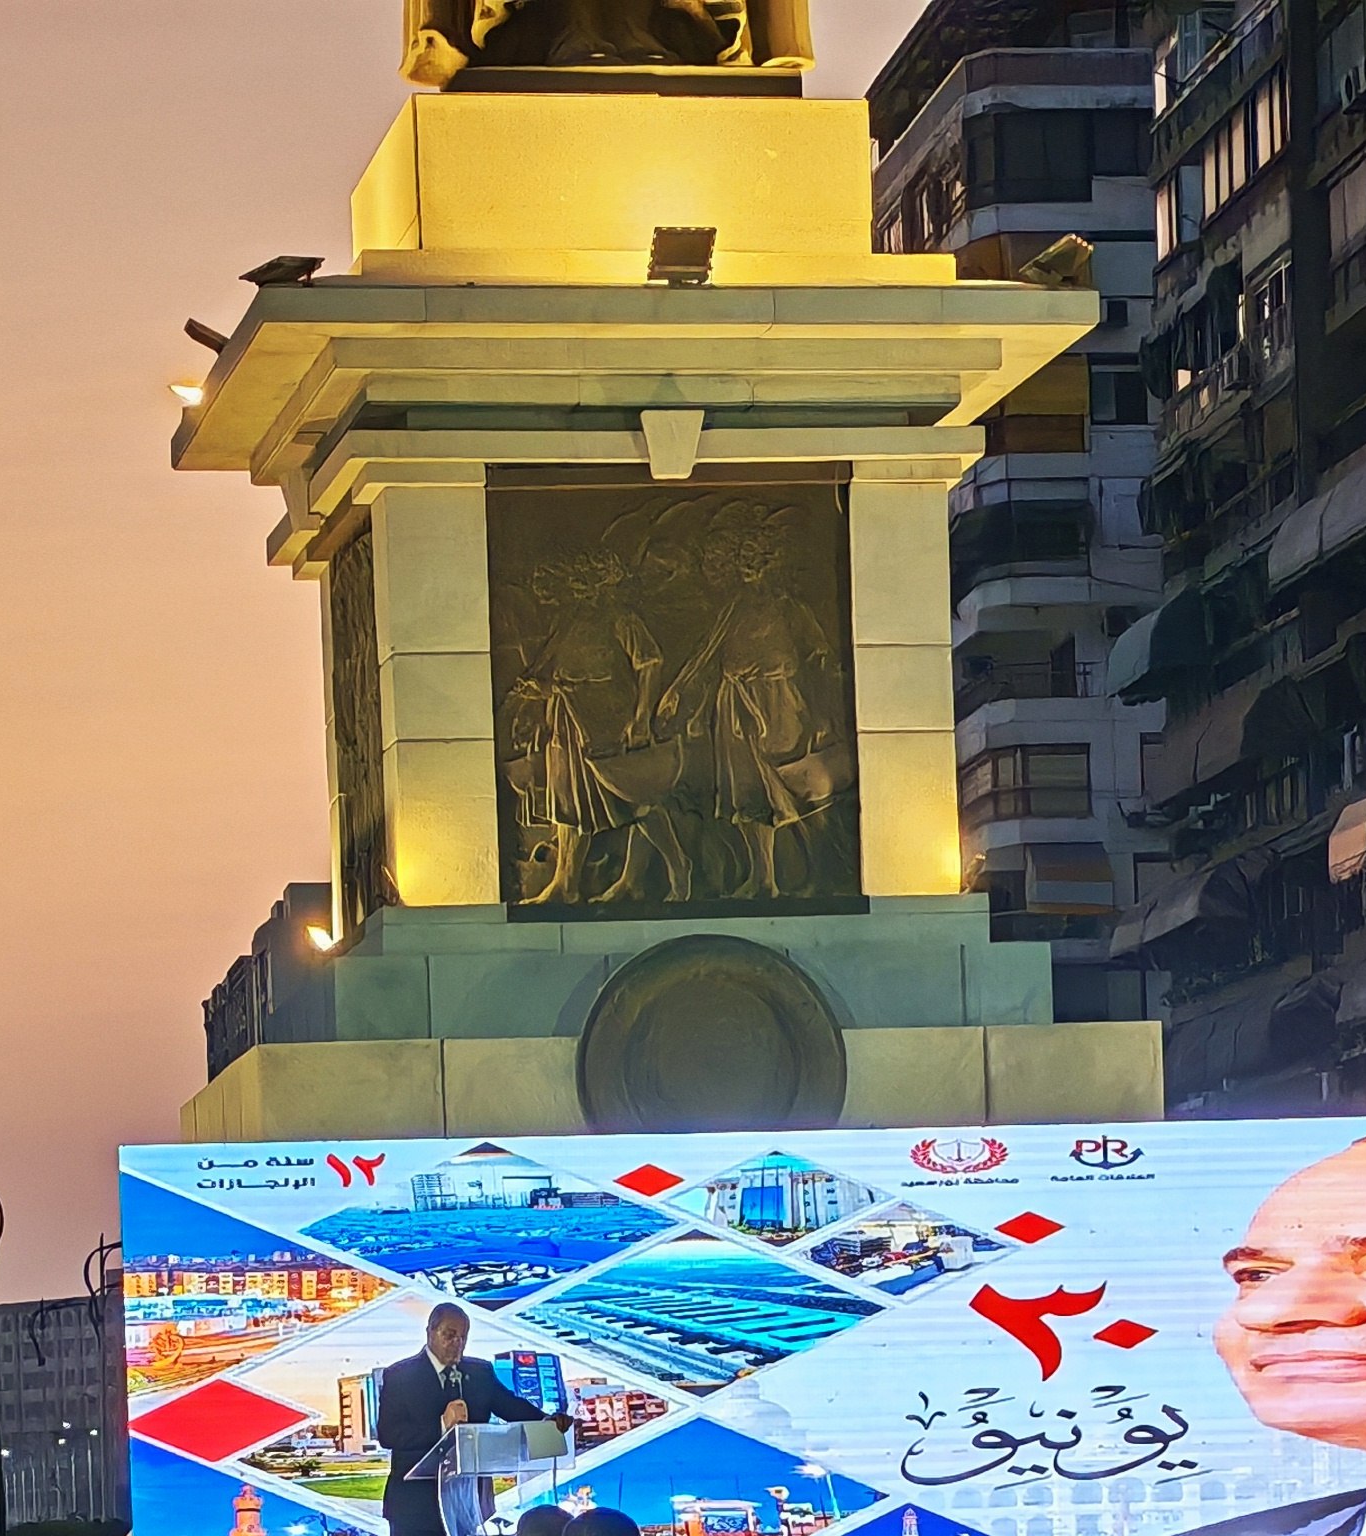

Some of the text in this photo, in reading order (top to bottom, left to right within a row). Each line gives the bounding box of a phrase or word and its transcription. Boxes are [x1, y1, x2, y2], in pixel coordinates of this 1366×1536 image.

[197, 1153, 386, 1188] ١٢ سنة من
[969, 1280, 1159, 1382] ٣٠
